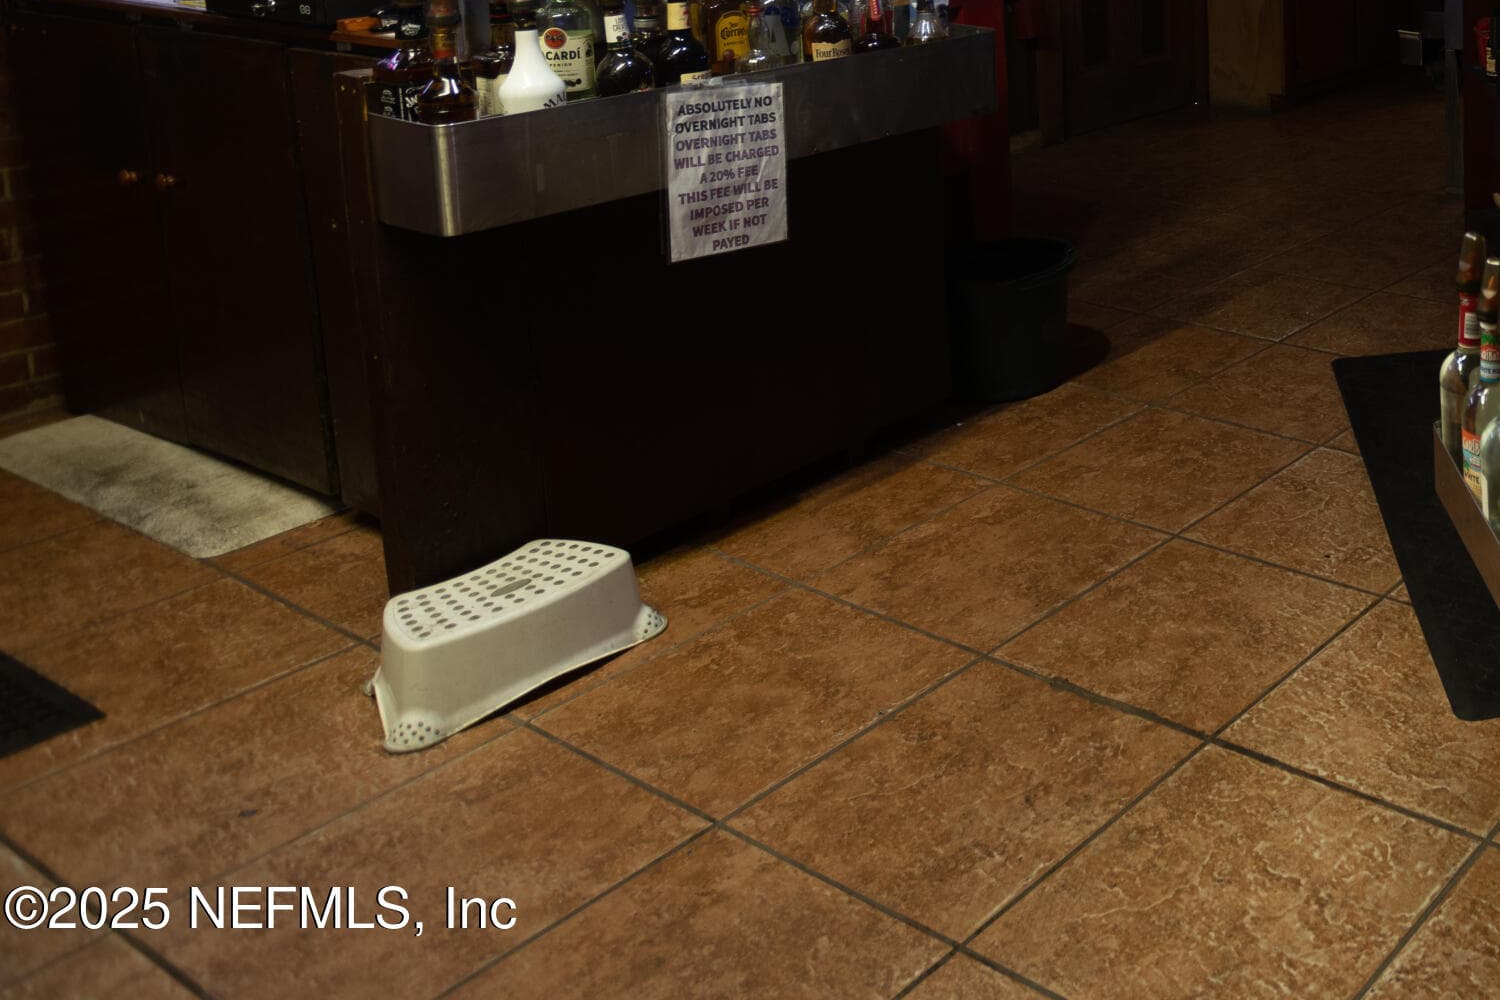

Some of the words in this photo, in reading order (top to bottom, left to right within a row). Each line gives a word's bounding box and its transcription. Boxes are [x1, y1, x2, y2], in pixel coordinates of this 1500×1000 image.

[545, 47, 582, 61] CARDÍ
[815, 48, 831, 58] Four
[678, 98, 752, 116] ABSOLUTELY
[754, 96, 772, 109] NO
[675, 116, 746, 134] OVERNIGHT
[749, 112, 776, 125] TABS
[676, 133, 746, 151] OVERNIGHT
[749, 129, 777, 142] TABS
[674, 156, 705, 170] WILL
[708, 153, 722, 165] BE
[725, 146, 779, 163] CHARGED
[699, 172, 708, 184] A
[710, 169, 735, 182] 20%
[737, 165, 759, 178] FEE
[678, 190, 708, 205] THIS
[710, 186, 731, 201] FEE
[733, 182, 762, 196] WILL
[764, 179, 779, 190] BE
[690, 201, 744, 221] IMPOSED
[746, 197, 769, 210] PER
[692, 222, 727, 237] WEEK
[729, 219, 740, 231] IF
[743, 213, 768, 227] NOT
[712, 234, 750, 251] PAYED
